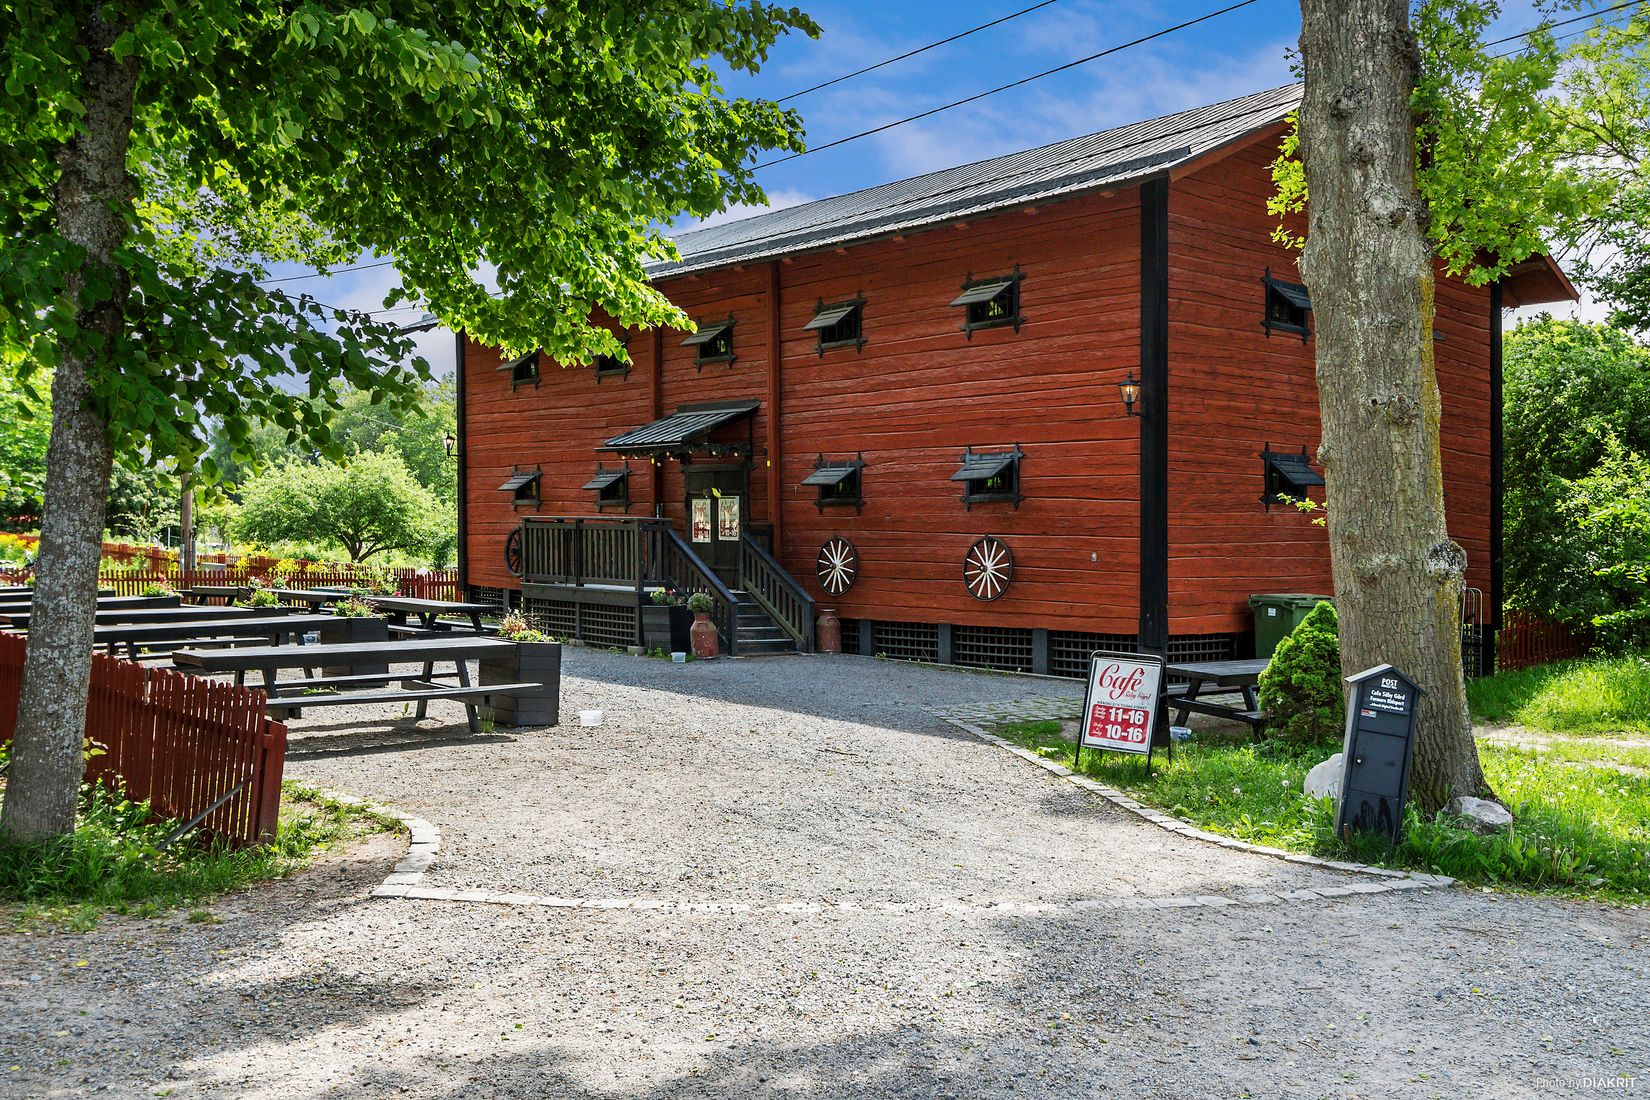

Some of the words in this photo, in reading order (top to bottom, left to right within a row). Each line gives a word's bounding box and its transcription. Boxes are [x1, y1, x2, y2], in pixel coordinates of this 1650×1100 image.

[1099, 663, 1145, 700] Café
[1382, 678, 1398, 687] POST
[1109, 707, 1144, 725] 11-16
[1106, 724, 1143, 742] 10-16
